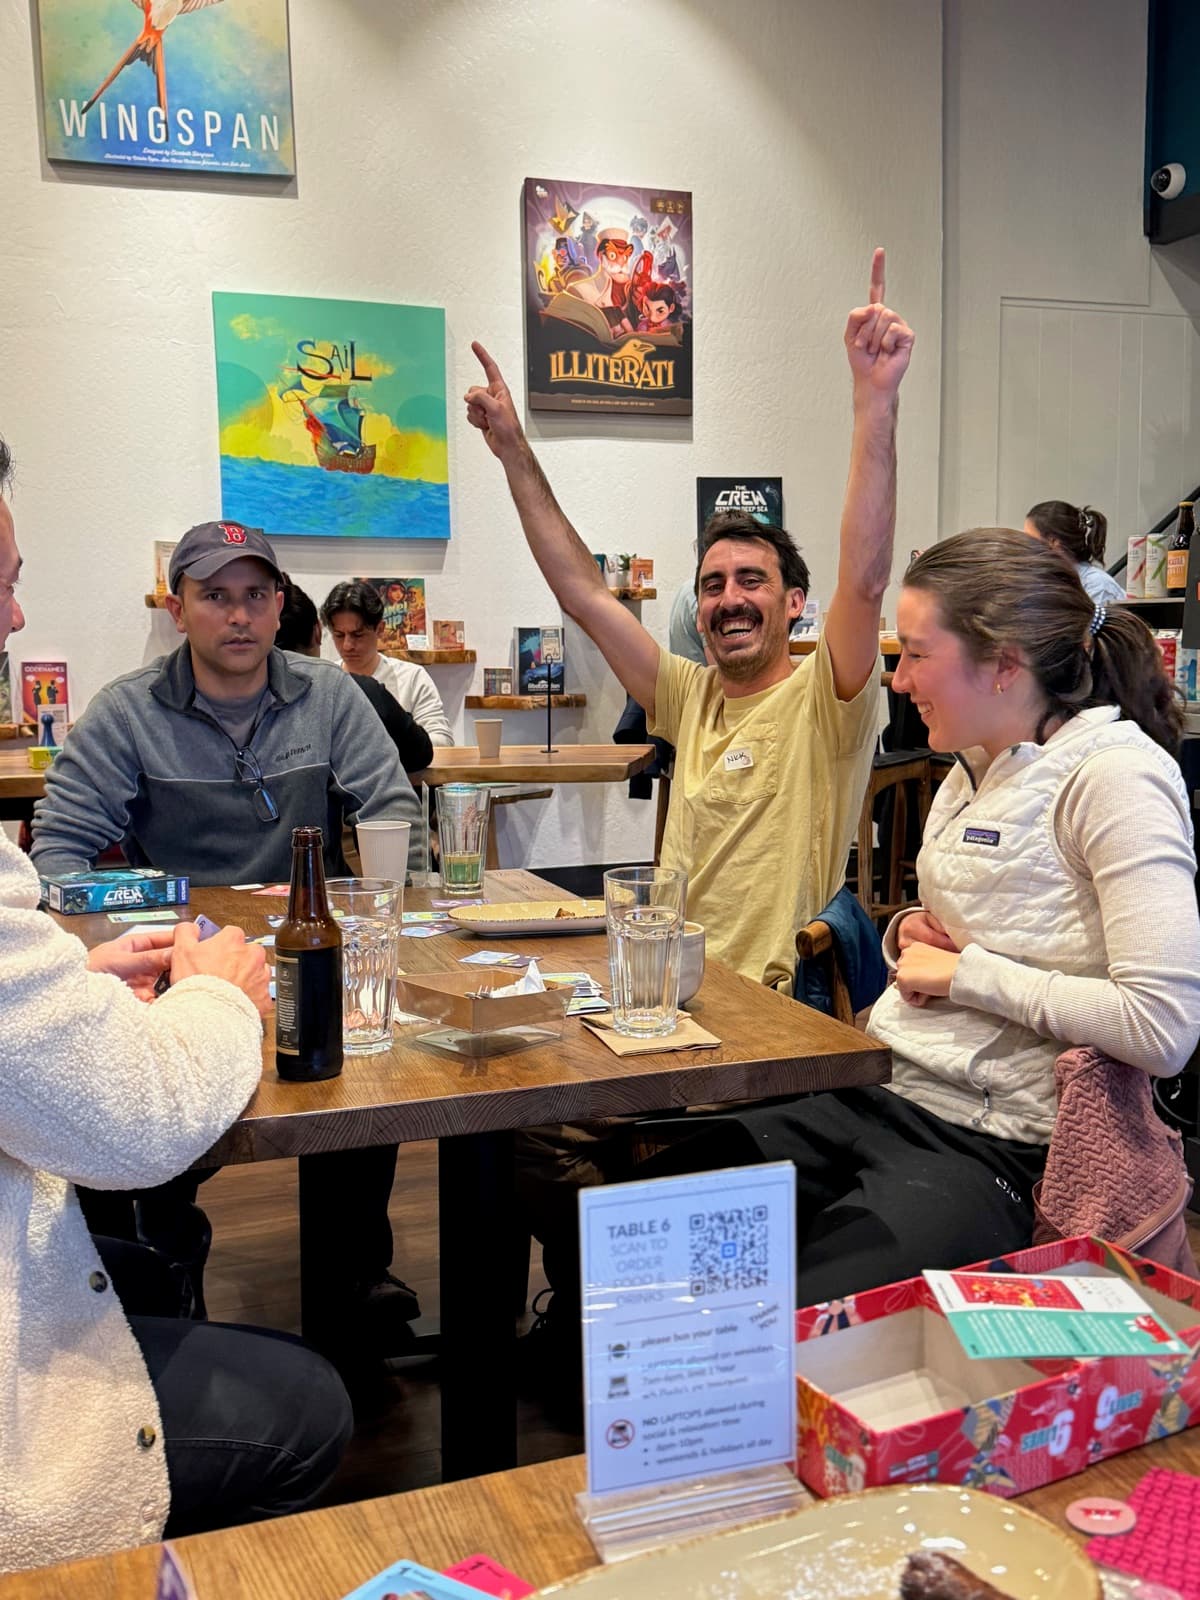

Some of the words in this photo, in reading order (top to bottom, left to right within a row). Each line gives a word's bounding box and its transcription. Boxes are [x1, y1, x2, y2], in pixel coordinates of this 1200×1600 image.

[58, 98, 280, 151] WINGSPAN
[549, 351, 675, 389] ILLITERATI
[715, 490, 767, 506] CREW
[103, 888, 144, 901] CREW
[607, 1219, 657, 1239] TABLE
[661, 1217, 672, 1233] 6
[610, 1240, 647, 1257] SCAN
[650, 1238, 668, 1251] TO
[616, 1256, 662, 1273] ORDER
[641, 1335, 671, 1348] please
[673, 1332, 690, 1342] bus
[692, 1329, 713, 1340] your
[715, 1324, 738, 1335] table
[642, 1416, 658, 1427] NO
[660, 1408, 702, 1425] LAPTOPS
[704, 1403, 737, 1417] allowed
[738, 1400, 765, 1411] during
[642, 1428, 667, 1440] social
[721, 1417, 741, 1426] time
[656, 1452, 699, 1465] weekends
